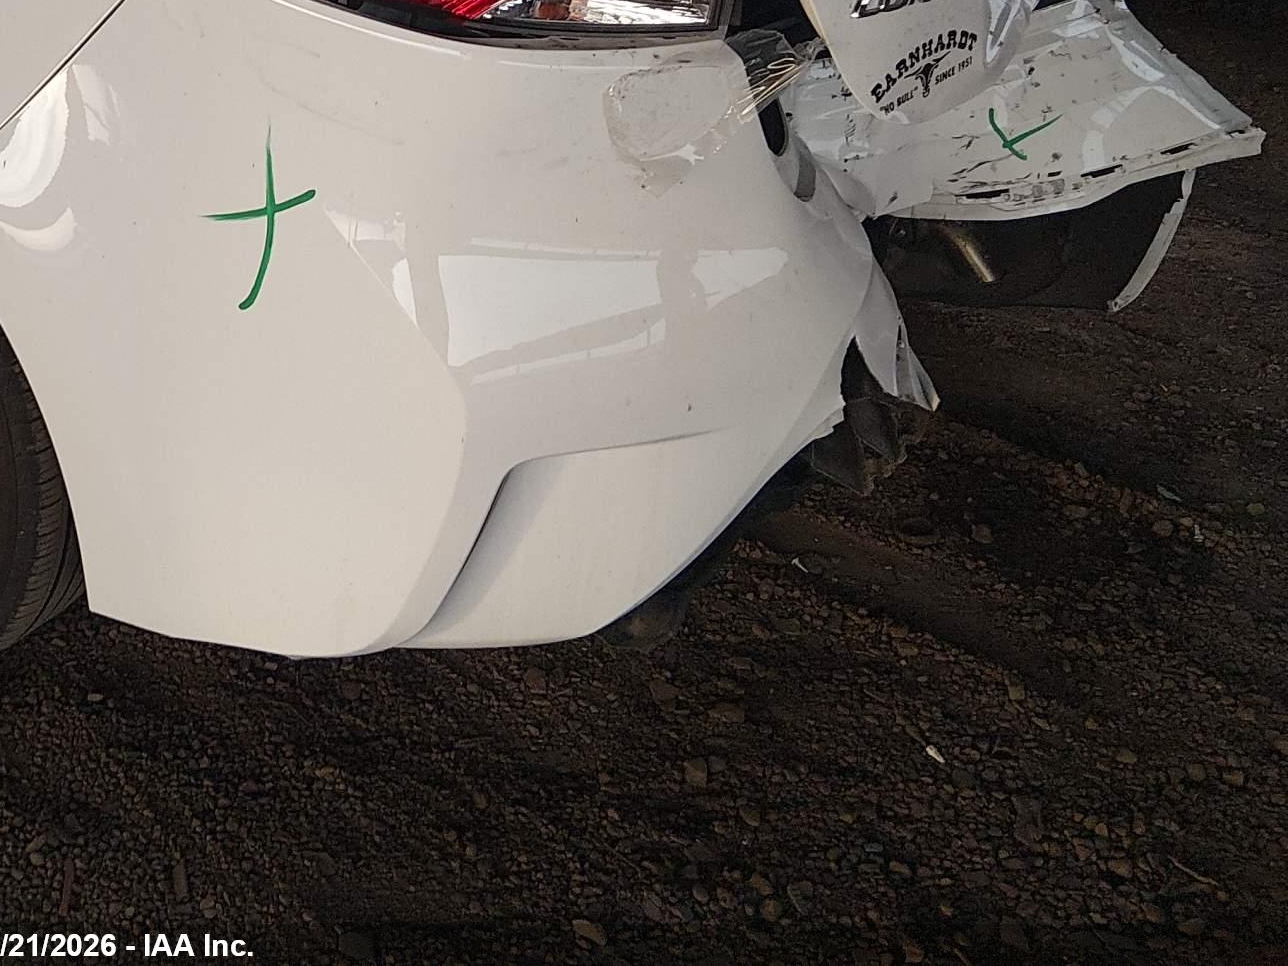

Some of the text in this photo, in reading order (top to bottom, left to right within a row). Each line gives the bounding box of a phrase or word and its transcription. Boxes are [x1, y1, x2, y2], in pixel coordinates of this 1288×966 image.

[871, 29, 978, 104] EARNHARDT
[934, 67, 956, 85] SINCE
[958, 55, 973, 73] 1951
